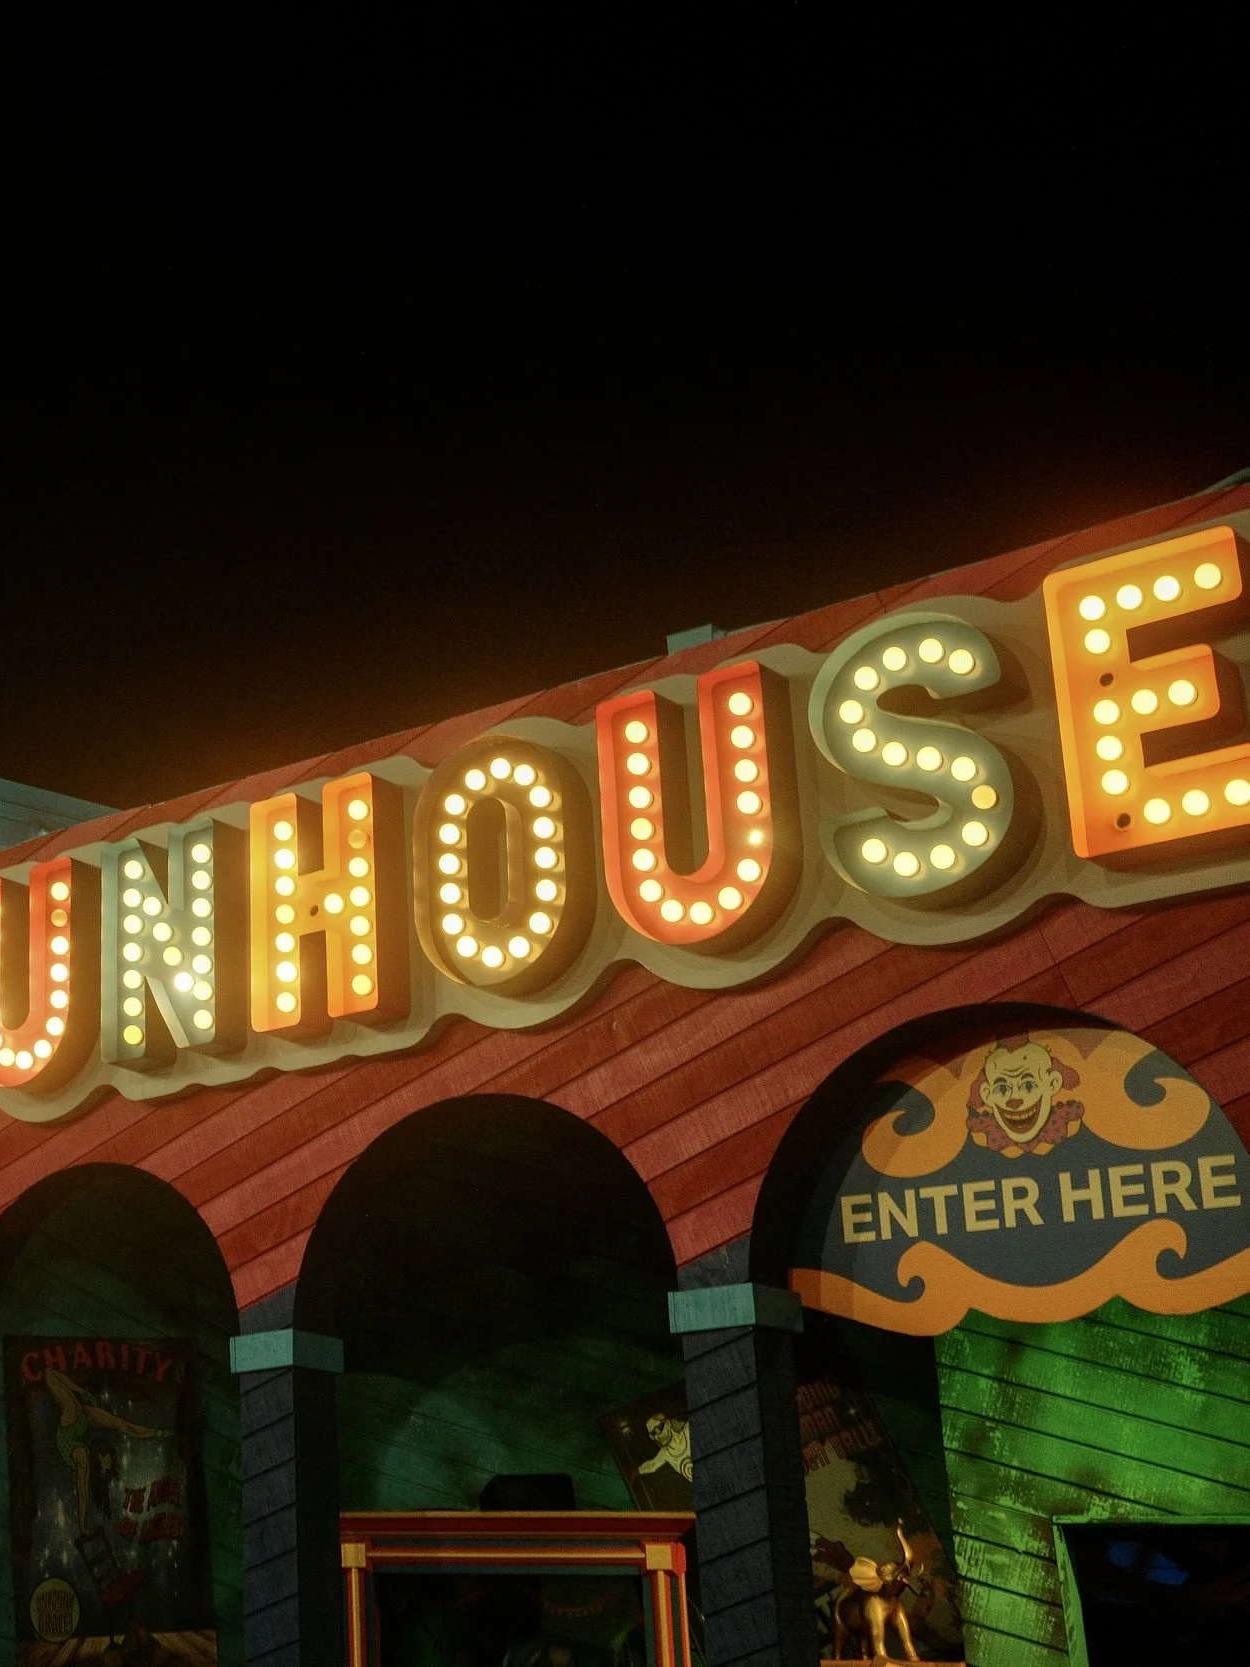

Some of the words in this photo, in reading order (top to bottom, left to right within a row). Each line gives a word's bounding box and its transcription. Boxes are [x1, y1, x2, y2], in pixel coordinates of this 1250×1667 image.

[840, 1176, 1045, 1244] ENTER
[1058, 1154, 1242, 1223] HERE
[20, 1339, 173, 1384] CHARITY
